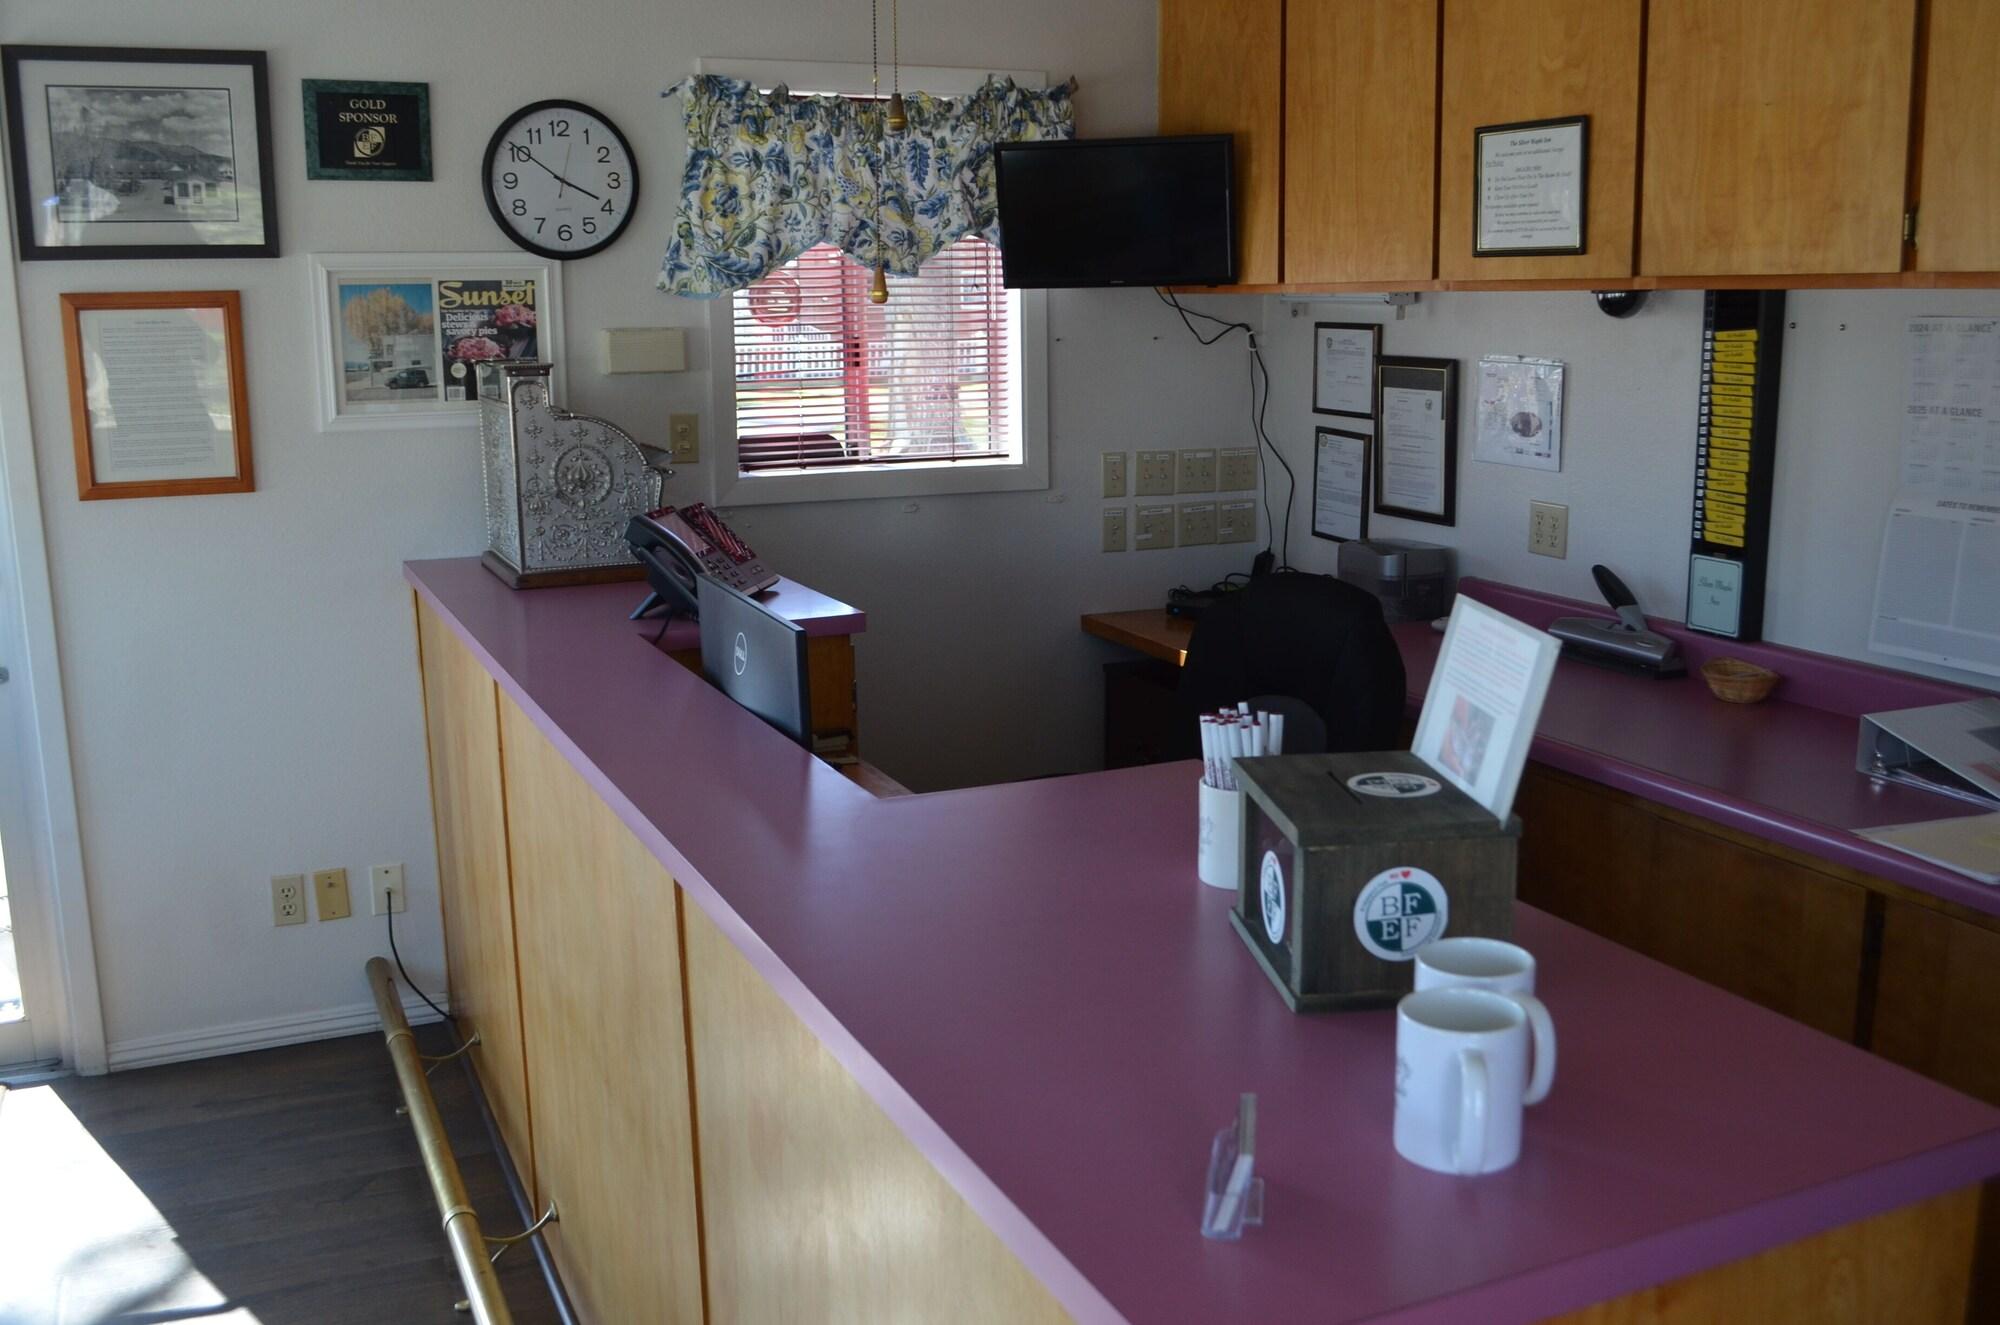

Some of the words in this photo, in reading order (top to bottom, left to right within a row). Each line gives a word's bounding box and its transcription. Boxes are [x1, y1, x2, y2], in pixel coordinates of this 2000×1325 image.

[350, 99, 387, 110] GOLD
[338, 112, 398, 124] SPONSOR
[526, 127, 542, 145] 11
[548, 119, 571, 137] 12
[583, 128, 590, 145] 1
[508, 145, 531, 163] 10
[597, 146, 611, 163] 2
[502, 172, 518, 189] 9
[607, 172, 621, 189] 3
[512, 199, 527, 216] 8
[600, 198, 615, 216] 4
[533, 217, 547, 234] 7
[557, 224, 573, 241] 6
[582, 216, 597, 234] 5
[440, 281, 535, 308] Sunset
[445, 313, 489, 321] Delicious
[479, 327, 498, 336] pies
[736, 645, 745, 661] DELL
